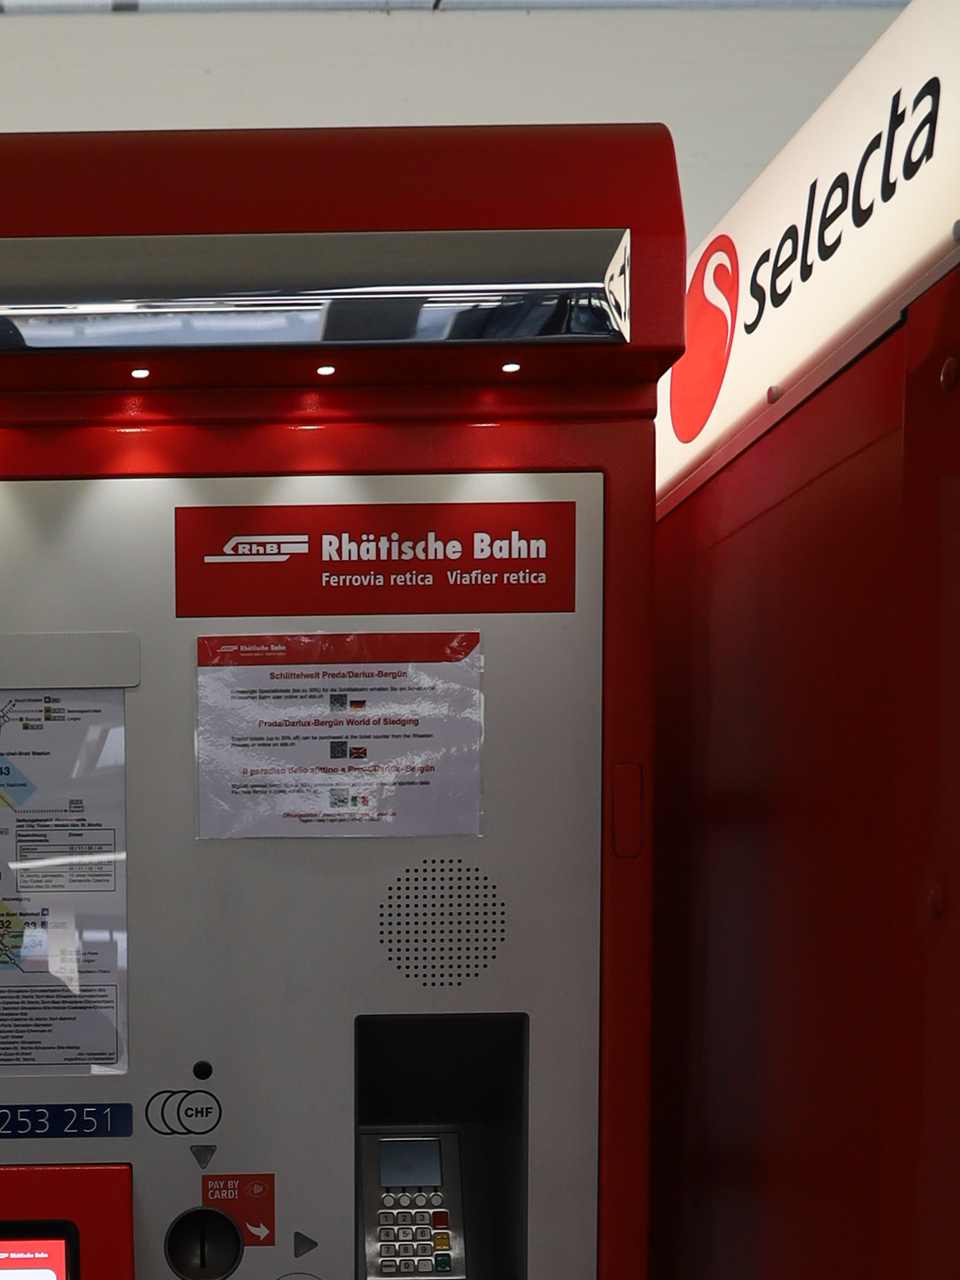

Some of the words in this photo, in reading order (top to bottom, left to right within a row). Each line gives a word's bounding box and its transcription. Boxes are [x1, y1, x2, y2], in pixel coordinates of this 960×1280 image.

[743, 75, 941, 335] selecta
[238, 543, 280, 556] RhB
[321, 531, 463, 562] Rhätische
[473, 530, 547, 561] Bahn
[321, 571, 384, 587] Ferrovia
[390, 570, 434, 586] retica
[447, 569, 497, 586] Viafier
[503, 569, 547, 585] retica
[346, 718, 371, 727] World
[373, 718, 382, 727] of
[184, 1106, 213, 1119] CHF
[63, 1106, 113, 1133] 251
[208, 1179, 225, 1190] PAY
[227, 1179, 240, 1189] BY
[208, 1189, 239, 1200] CARD!
